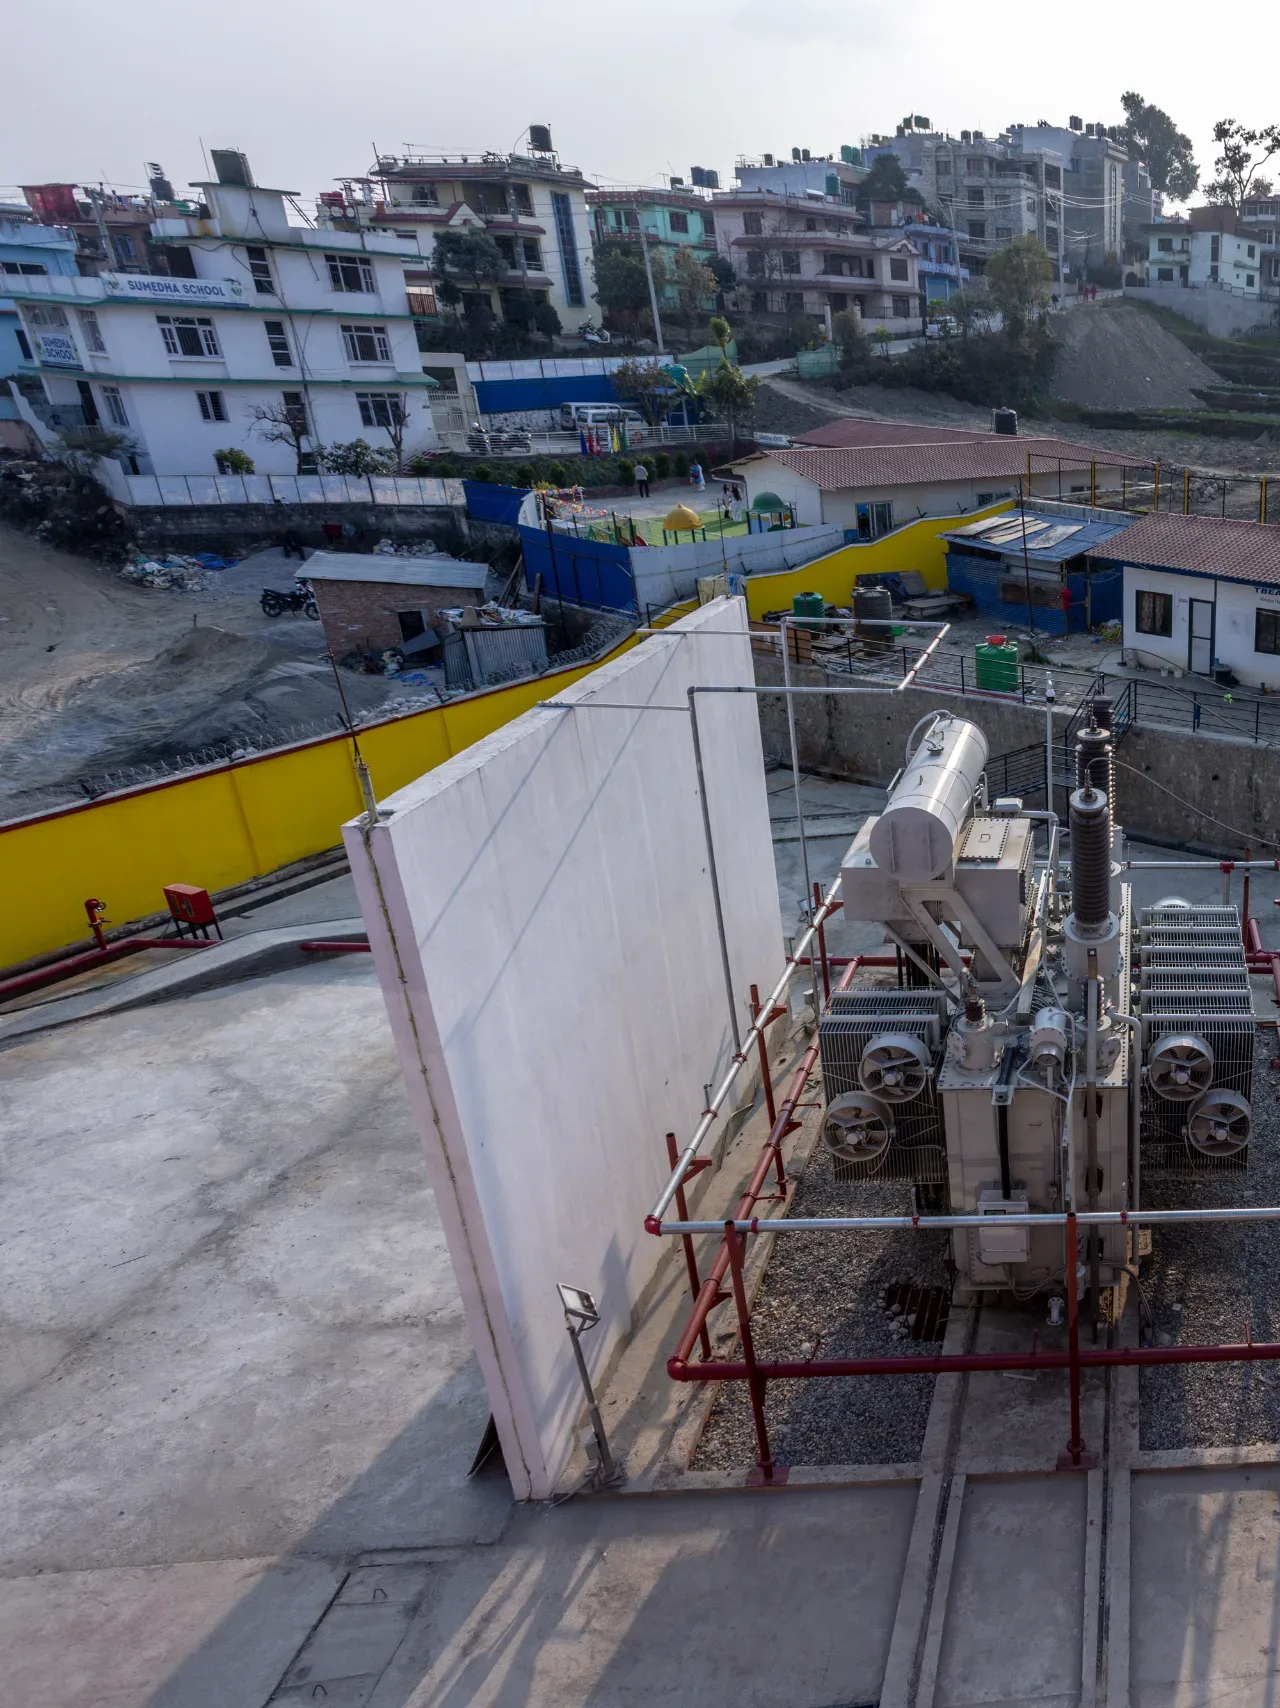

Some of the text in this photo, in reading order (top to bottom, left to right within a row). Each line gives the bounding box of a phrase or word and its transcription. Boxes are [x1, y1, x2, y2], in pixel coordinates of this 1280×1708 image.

[127, 280, 181, 294] SUMEDHA
[183, 284, 226, 297] SCHOOL
[41, 336, 72, 350] SUMEDHA
[45, 347, 76, 361] SCHOOL
